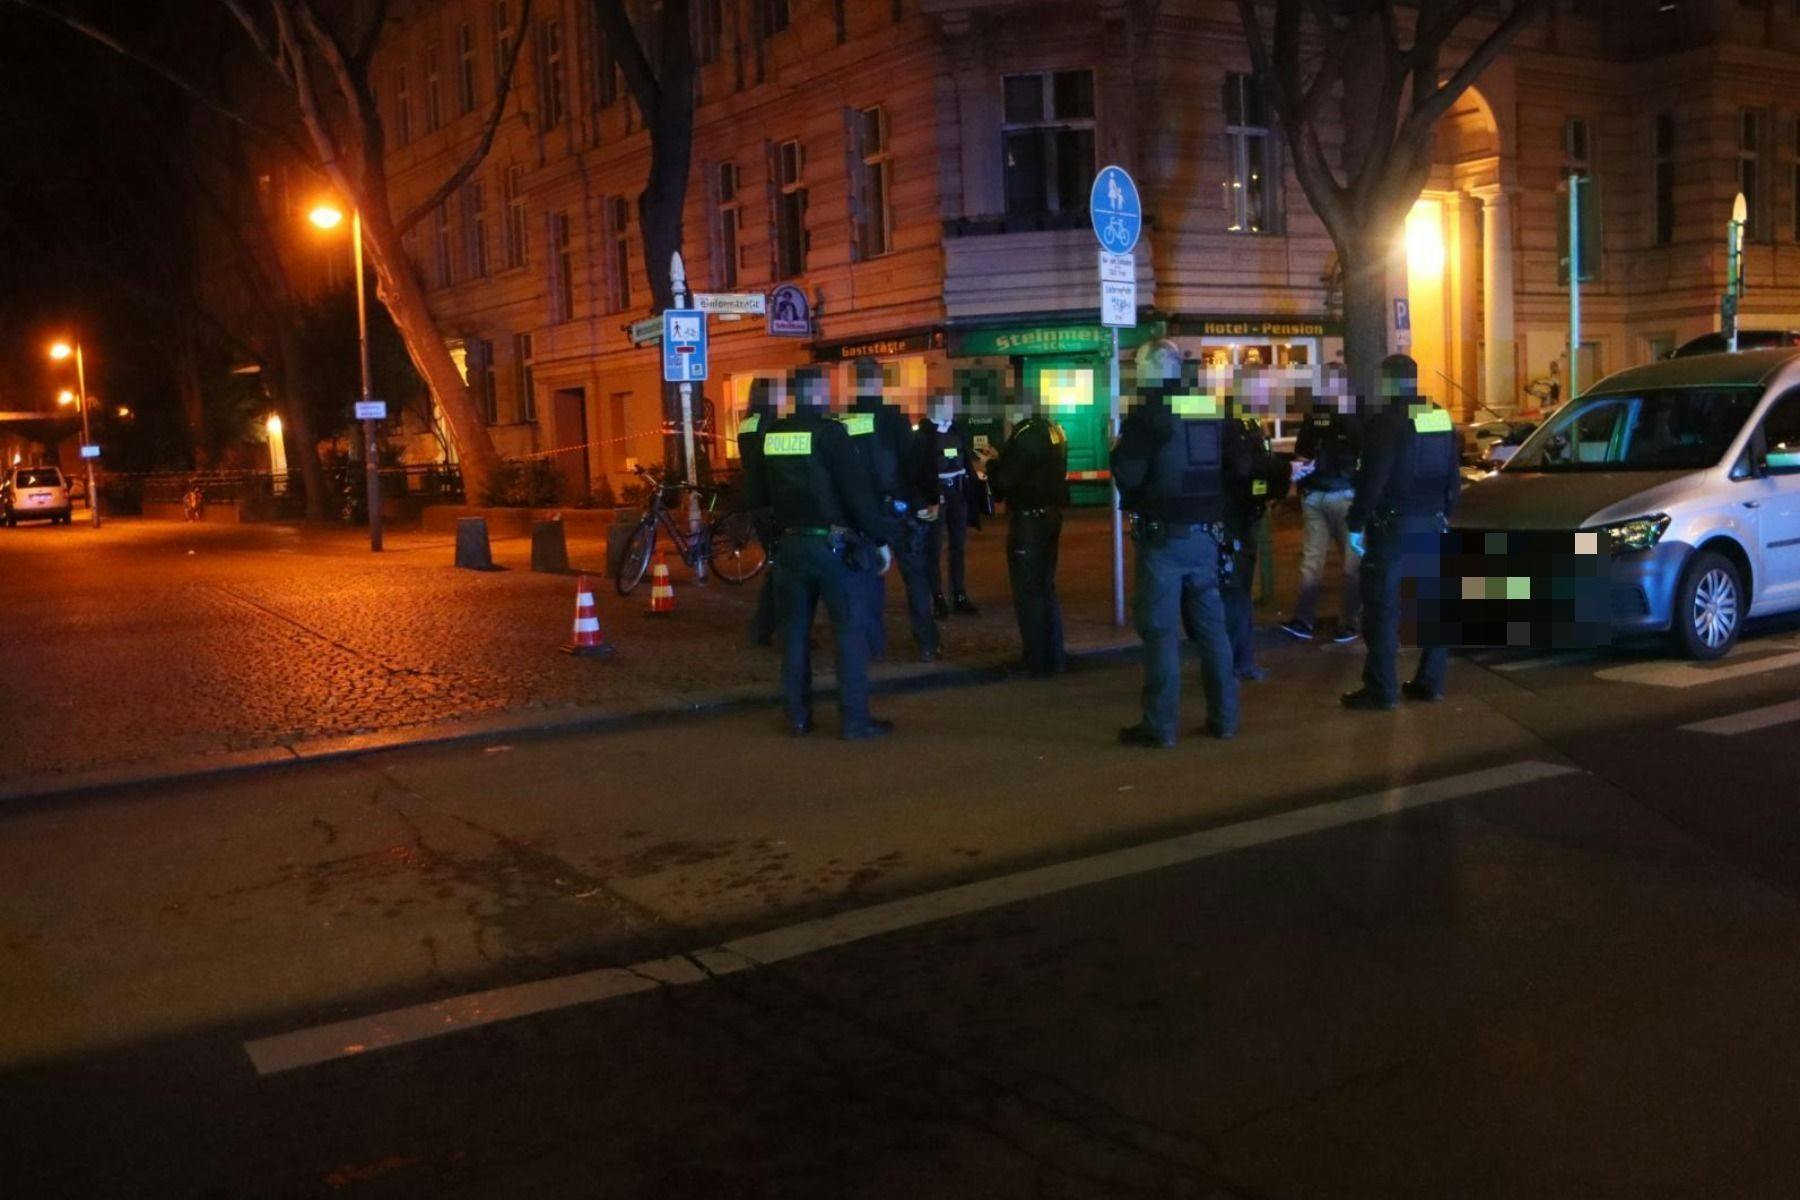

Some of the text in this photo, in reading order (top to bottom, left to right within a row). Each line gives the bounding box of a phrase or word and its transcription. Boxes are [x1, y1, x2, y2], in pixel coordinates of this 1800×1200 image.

[1203, 322, 1248, 334] Hotel
[1262, 322, 1324, 334] Pension
[995, 327, 1108, 351] Steinmet
[767, 435, 810, 452] POLIZEI
